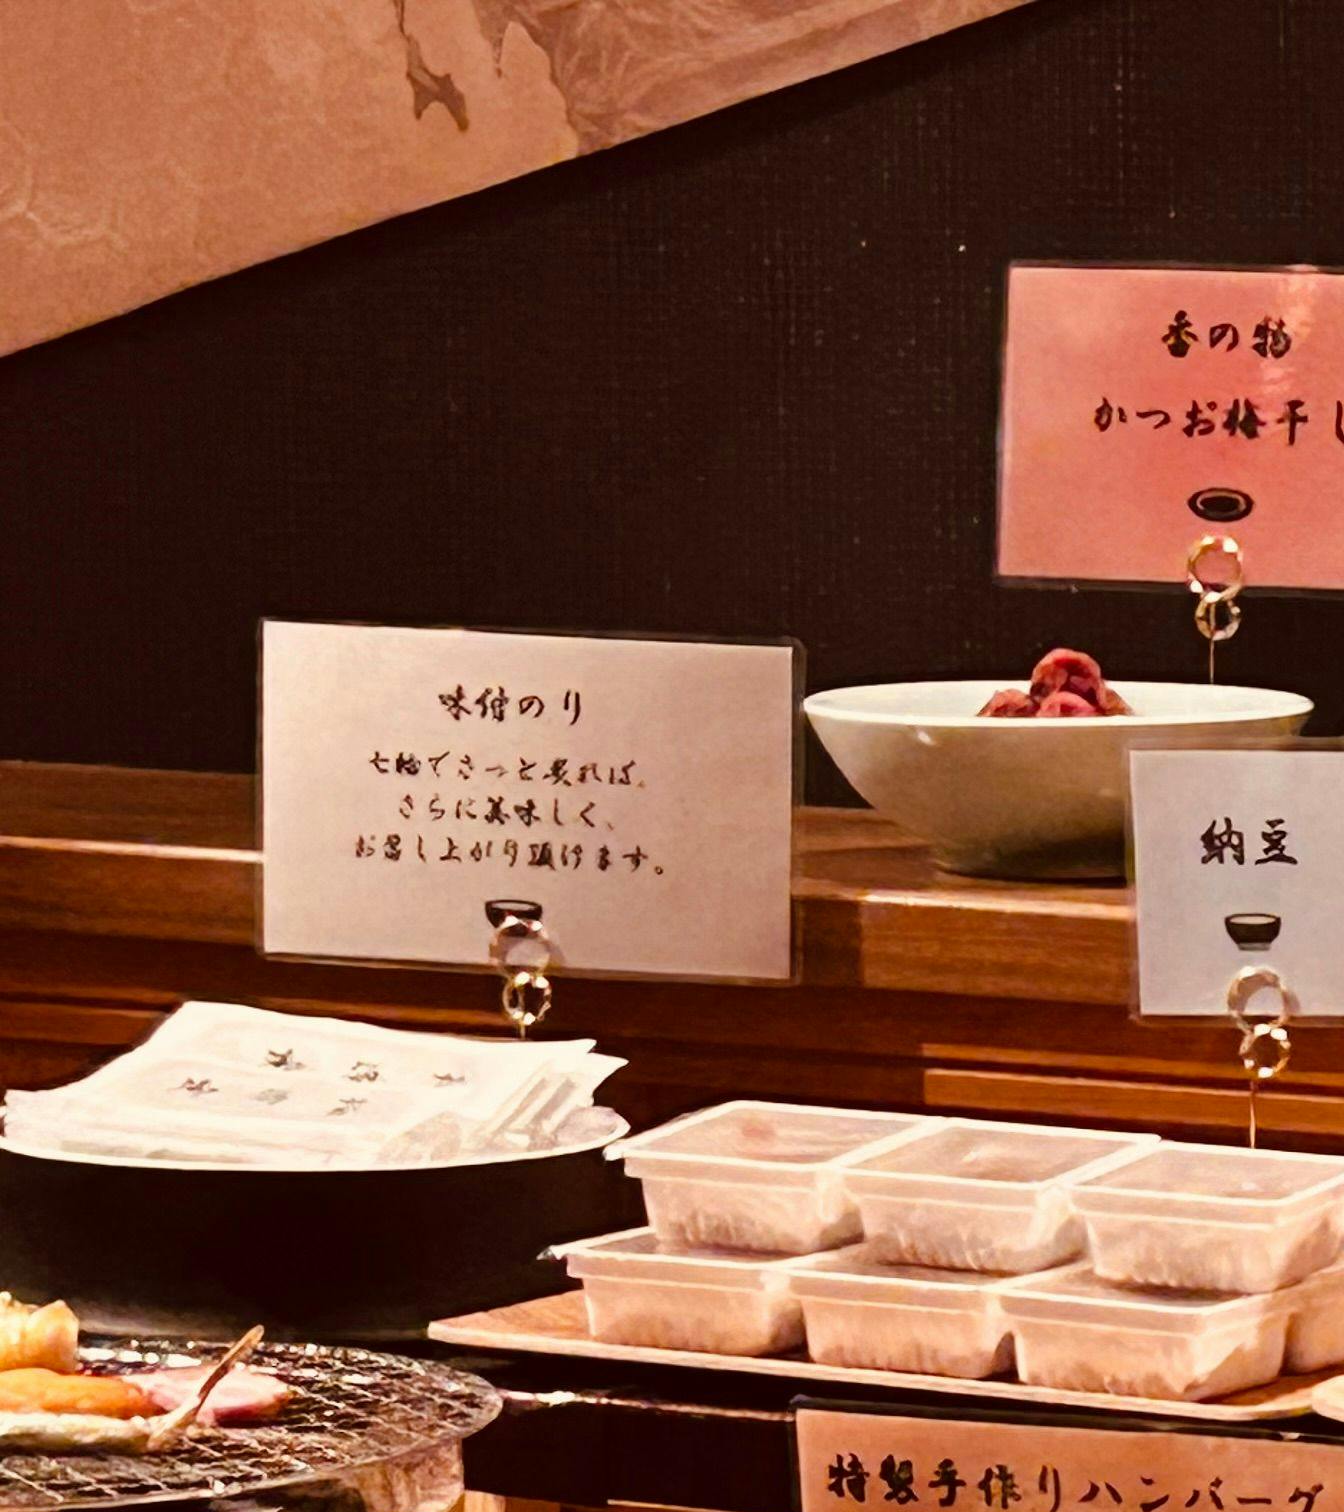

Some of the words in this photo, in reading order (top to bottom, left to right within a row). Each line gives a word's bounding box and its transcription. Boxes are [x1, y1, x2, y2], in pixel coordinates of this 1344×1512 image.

[1161, 309, 1292, 358] 香の物
[438, 684, 582, 726] 味付のり
[1200, 817, 1298, 866] 納豆
